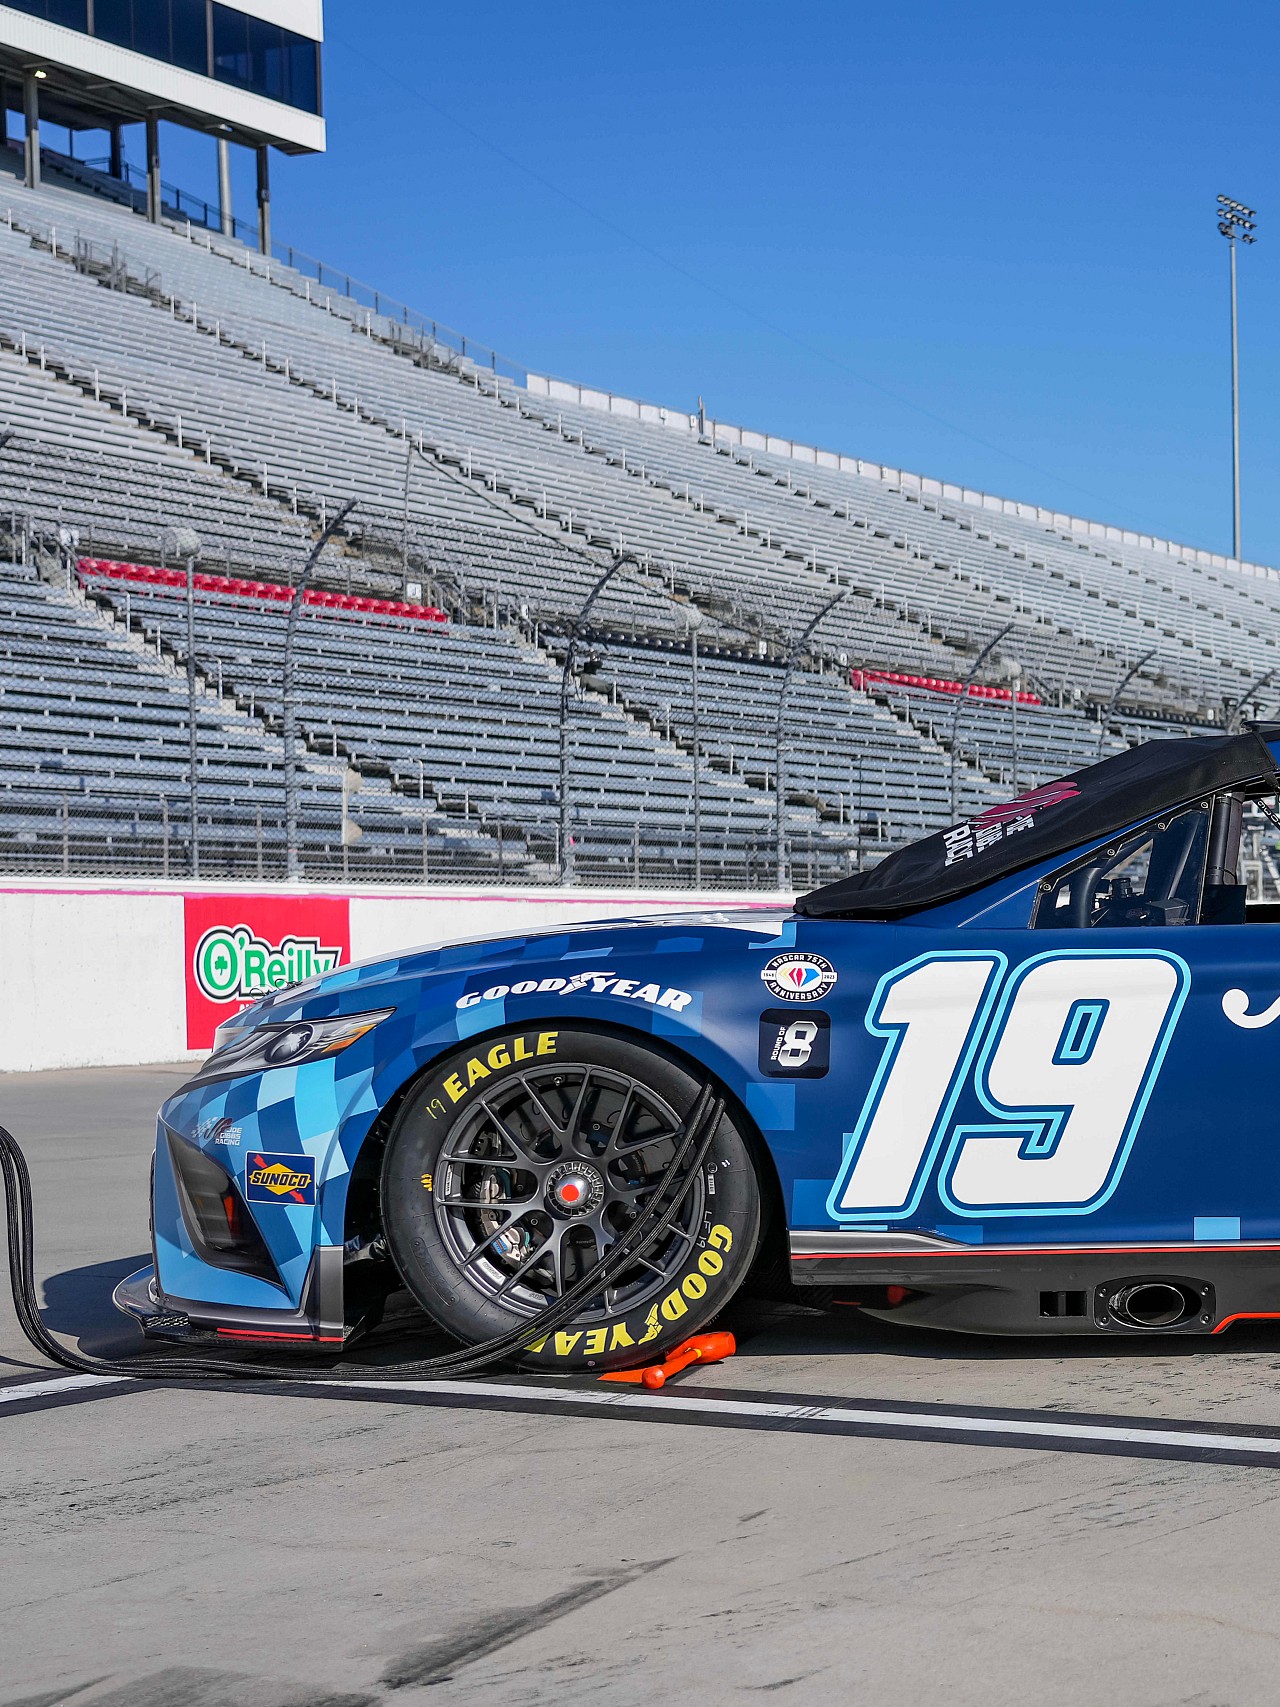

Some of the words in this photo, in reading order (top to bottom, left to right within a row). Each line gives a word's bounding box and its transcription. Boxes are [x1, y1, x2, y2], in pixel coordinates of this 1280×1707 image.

[771, 954, 805, 968] NASCAR
[807, 955, 828, 969] 75TH
[455, 972, 693, 1013] GOODYEAR
[769, 981, 828, 1000] ANNIVERSARY
[770, 1036, 784, 1060] ROUND
[778, 1026, 786, 1036] OF
[777, 1020, 818, 1067] 8
[443, 1031, 559, 1104] EAGLE
[831, 953, 1185, 1216] 19
[425, 1098, 447, 1120] 19
[214, 1138, 241, 1146] RACING
[219, 1132, 242, 1140] GIBBS
[251, 1171, 310, 1188] SUNOCO
